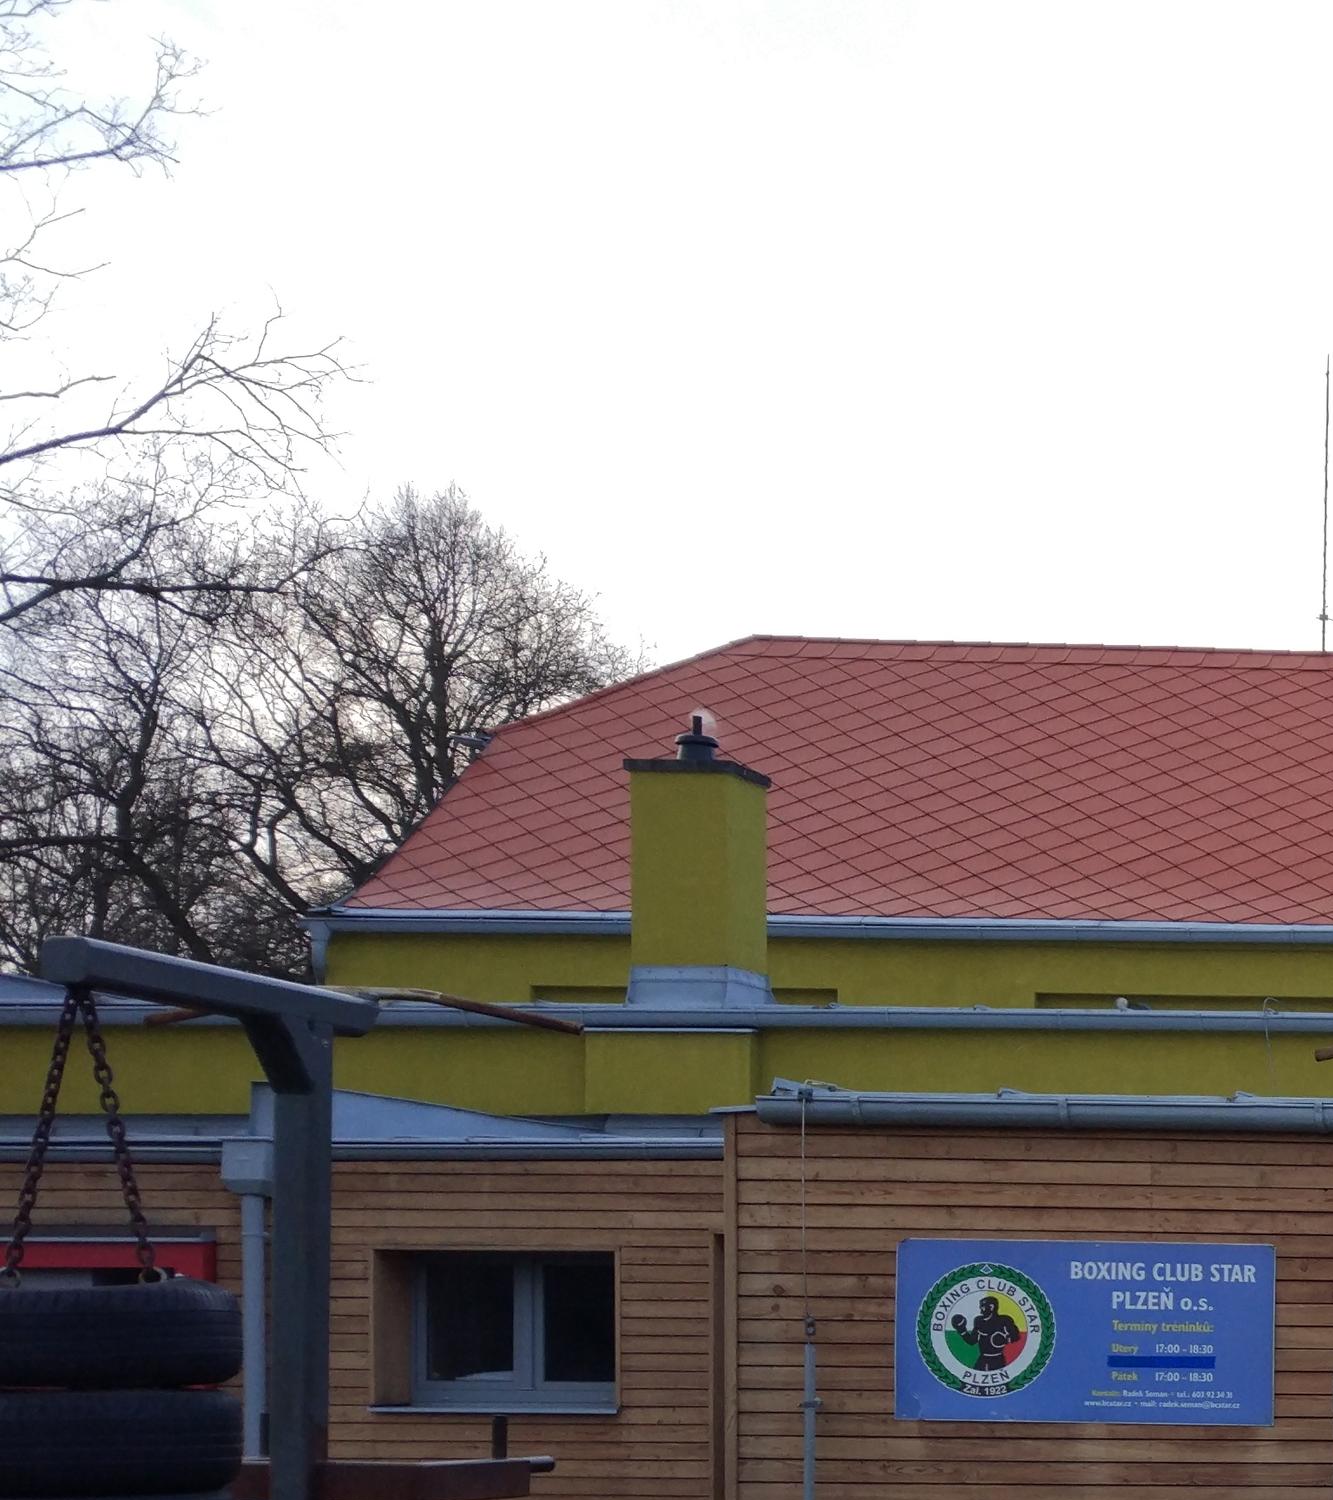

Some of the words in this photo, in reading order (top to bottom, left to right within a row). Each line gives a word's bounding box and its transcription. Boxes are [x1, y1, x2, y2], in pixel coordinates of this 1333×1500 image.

[1070, 1261, 1146, 1281] BOXING
[1152, 1263, 1203, 1282] CLUB
[1210, 1264, 1256, 1283] STAR
[932, 1283, 971, 1332] BOXING
[977, 1279, 1017, 1297] CLUB
[1018, 1296, 1040, 1333] STAR
[1111, 1287, 1174, 1310] PLZEŇ
[1180, 1298, 1214, 1311] o.s.
[1155, 1344, 1180, 1353] 17:00
[1190, 1344, 1213, 1354] 18:30
[963, 1369, 1010, 1384] PLZEŇ
[1155, 1372, 1180, 1381] 17:00
[1190, 1372, 1213, 1382] 18:30
[984, 1385, 1007, 1395] 1922
